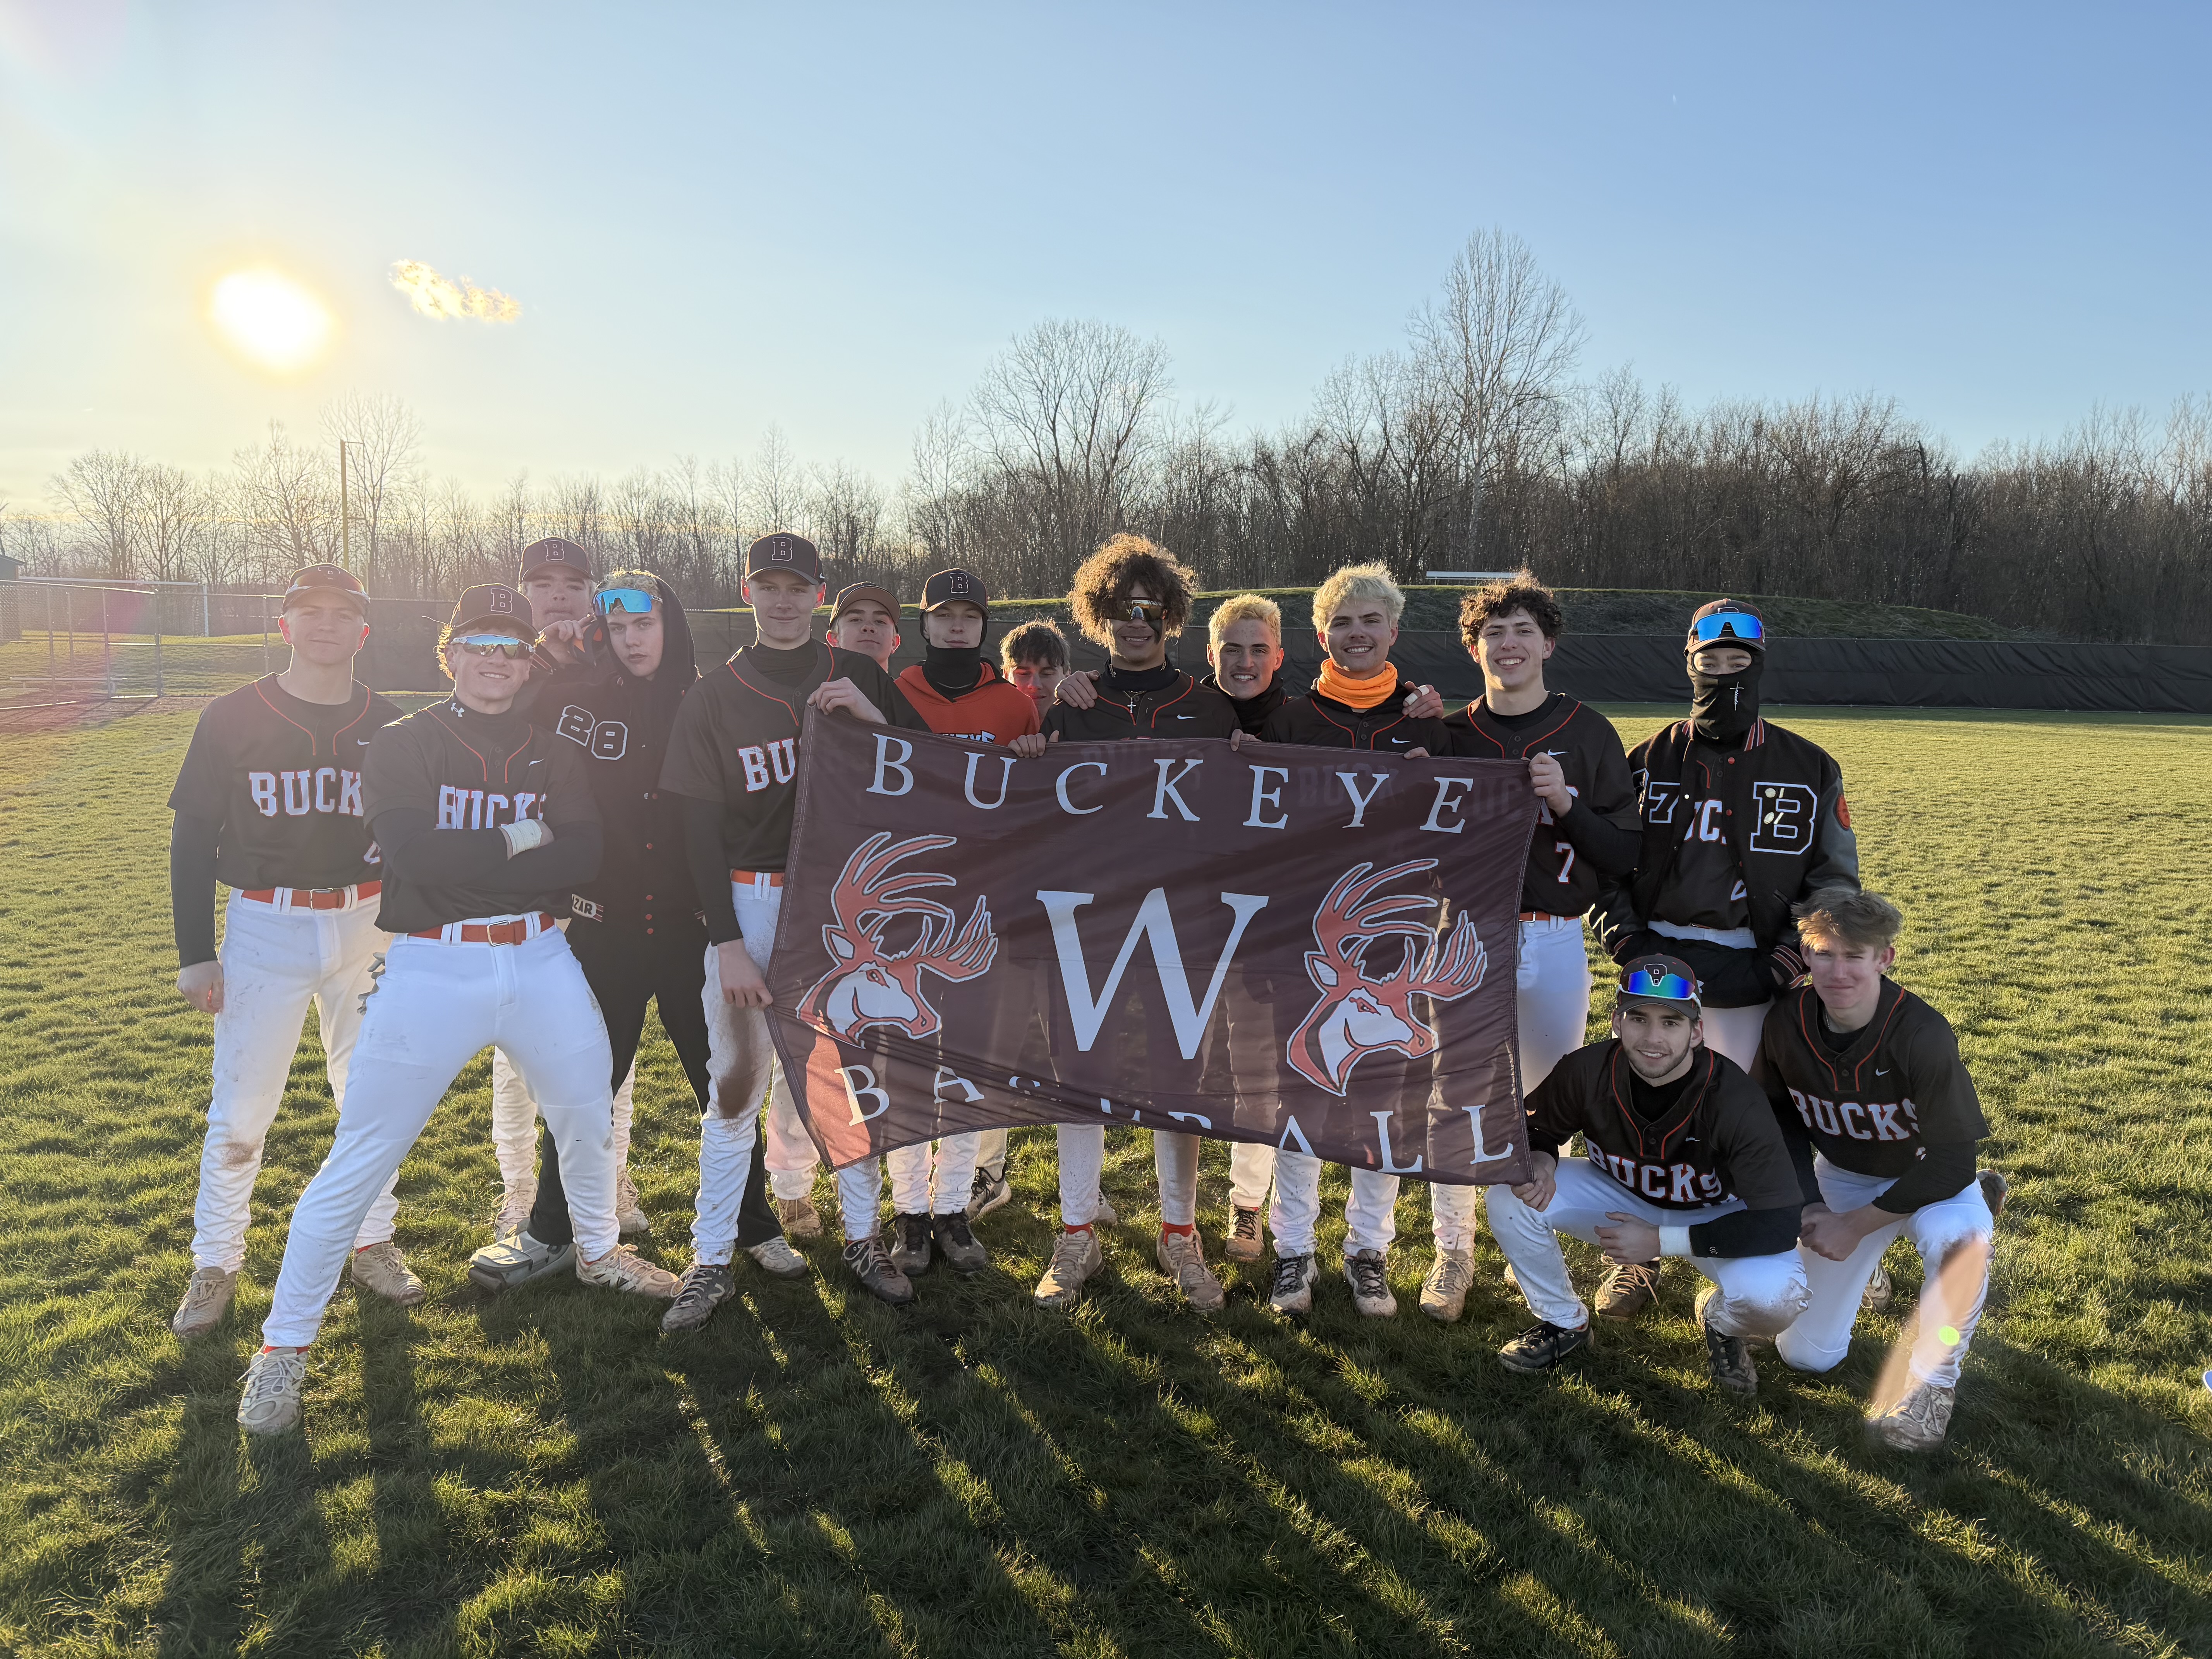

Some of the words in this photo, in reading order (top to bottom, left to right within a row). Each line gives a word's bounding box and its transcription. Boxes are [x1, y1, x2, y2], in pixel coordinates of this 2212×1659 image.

[544, 540, 565, 561] B
[771, 537, 793, 561] B
[490, 588, 512, 613] B
[949, 572, 969, 594] B
[556, 704, 628, 760] 28
[737, 737, 802, 793] BU
[866, 733, 1474, 834] BUCKEYE
[1750, 781, 1818, 855] B
[1555, 841, 1576, 884] 7
[572, 896, 592, 915] ZAR
[1036, 887, 1269, 1060] W
[833, 1065, 1513, 1173] BAALL
